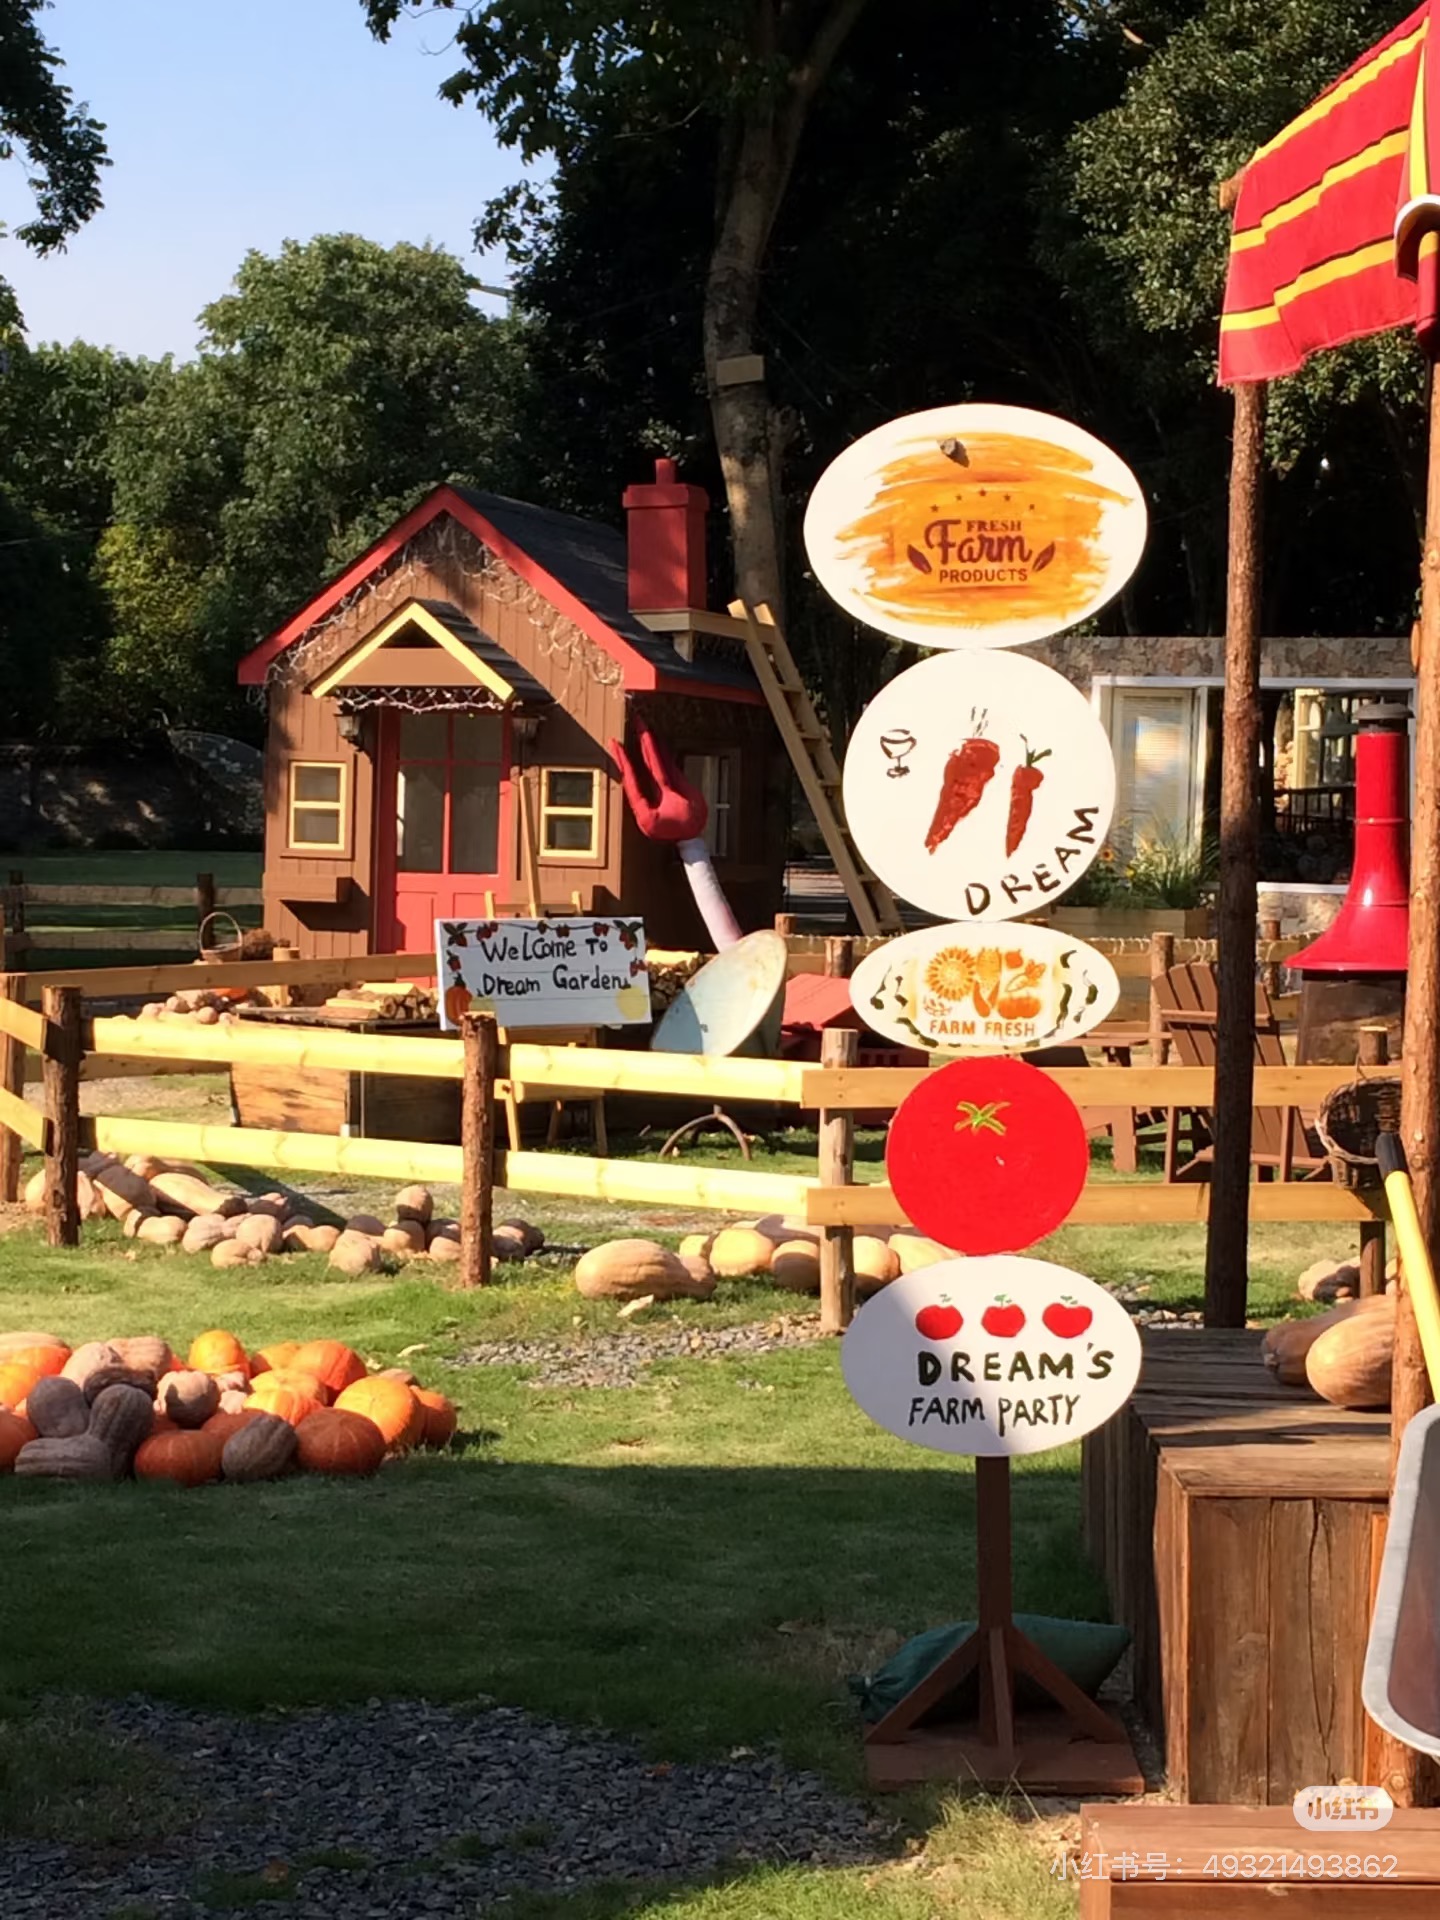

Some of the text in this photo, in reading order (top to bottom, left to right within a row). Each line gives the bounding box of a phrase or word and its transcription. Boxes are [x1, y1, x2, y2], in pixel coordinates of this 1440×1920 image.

[924, 519, 1033, 565] Farm
[966, 520, 1022, 532] FRESH
[939, 569, 1028, 583] PRODUCTS
[965, 806, 1099, 915] DREAM
[482, 973, 541, 996] Dream
[929, 1019, 1036, 1037] FARM FRESH
[917, 1342, 1115, 1386] DREAM'S
[908, 1394, 1081, 1437] FARM PARTY
